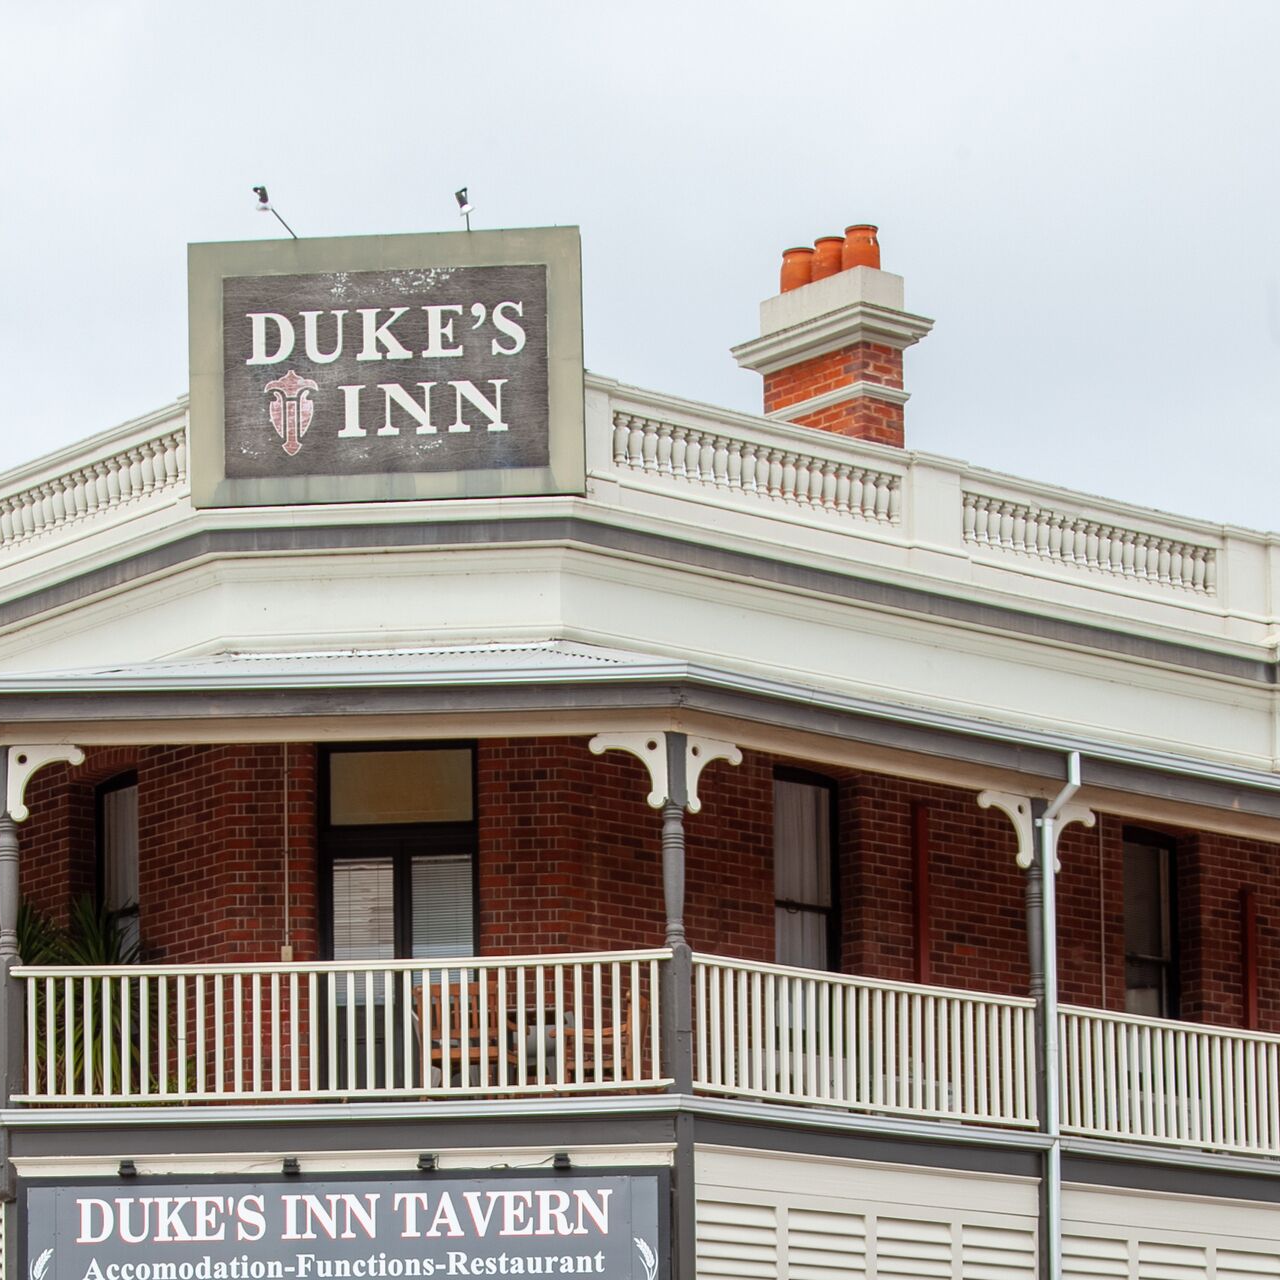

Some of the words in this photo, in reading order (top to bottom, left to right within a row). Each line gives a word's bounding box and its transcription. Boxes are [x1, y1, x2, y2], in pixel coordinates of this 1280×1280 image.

[245, 300, 527, 366] DUKE'S
[337, 378, 509, 438] INN
[75, 1195, 267, 1244] DUKE'S
[280, 1192, 380, 1241] INN
[394, 1188, 612, 1239] TAVERN
[82, 1250, 605, 1280] Accomodation-Functions-Restaurant
